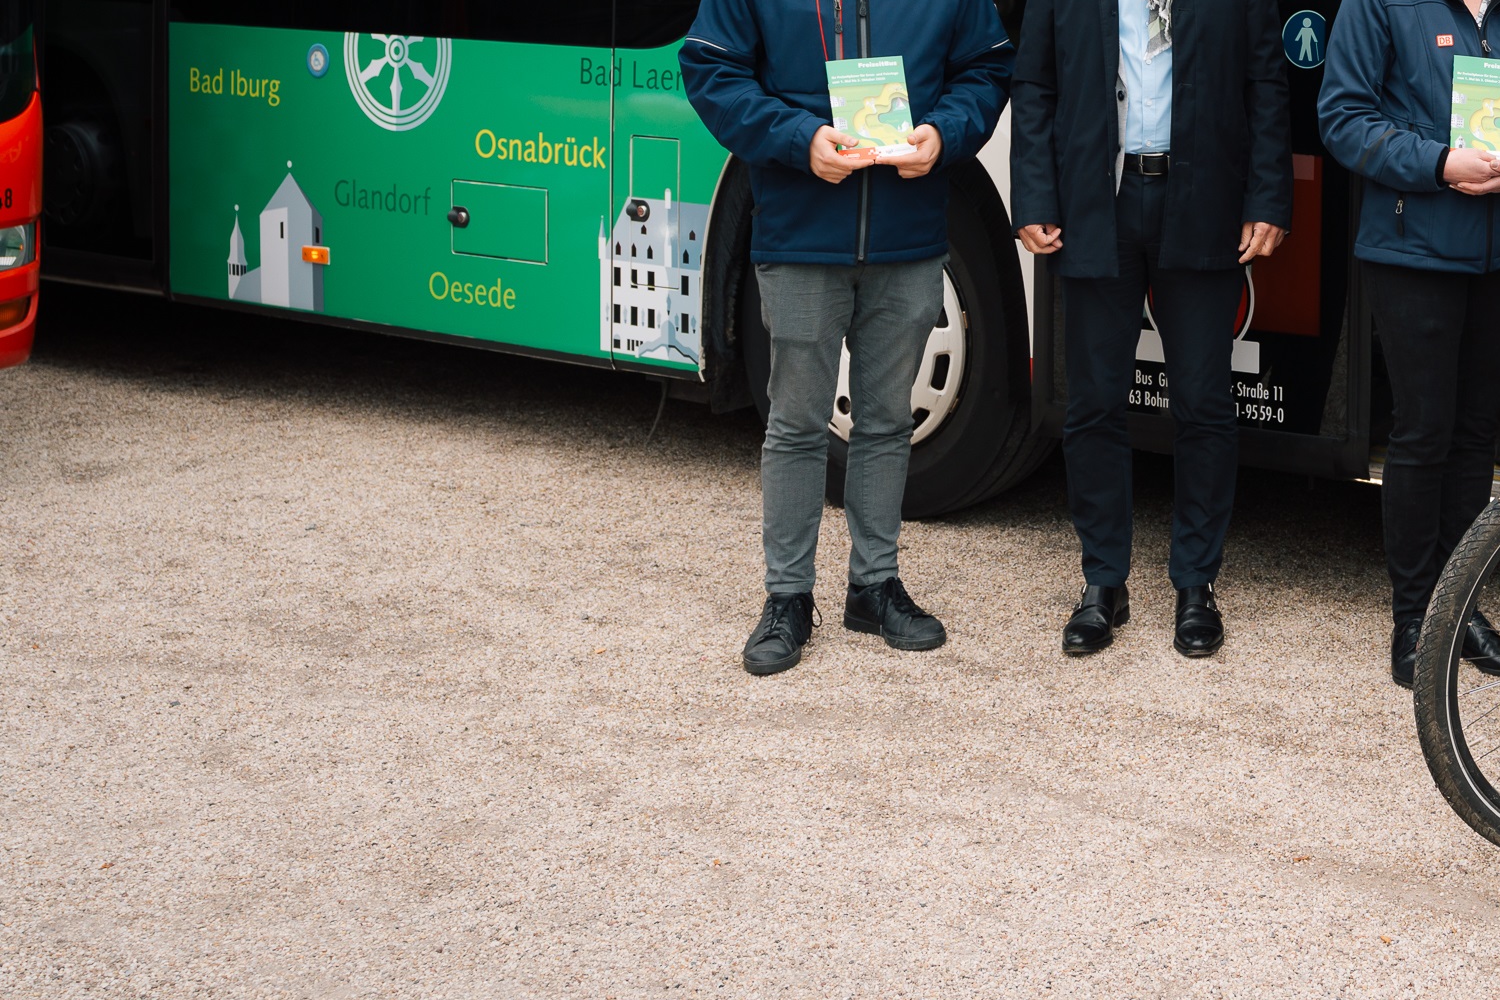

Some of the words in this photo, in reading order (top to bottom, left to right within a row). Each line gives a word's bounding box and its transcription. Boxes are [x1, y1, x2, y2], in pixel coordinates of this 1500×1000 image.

[189, 68, 224, 95] Bad
[230, 70, 281, 107] Iburg
[580, 57, 622, 88] Bad
[633, 60, 682, 92] Laer
[475, 129, 606, 169] Osnabrück
[334, 179, 432, 217] Glandorf
[429, 271, 517, 310] Oesede
[1135, 369, 1153, 386] Bus
[1237, 381, 1269, 400] Straße
[1274, 386, 1283, 402] 11
[1128, 390, 1142, 405] 63
[1144, 391, 1170, 409] Bohm
[1235, 402, 1284, 423] 1-9559-0
